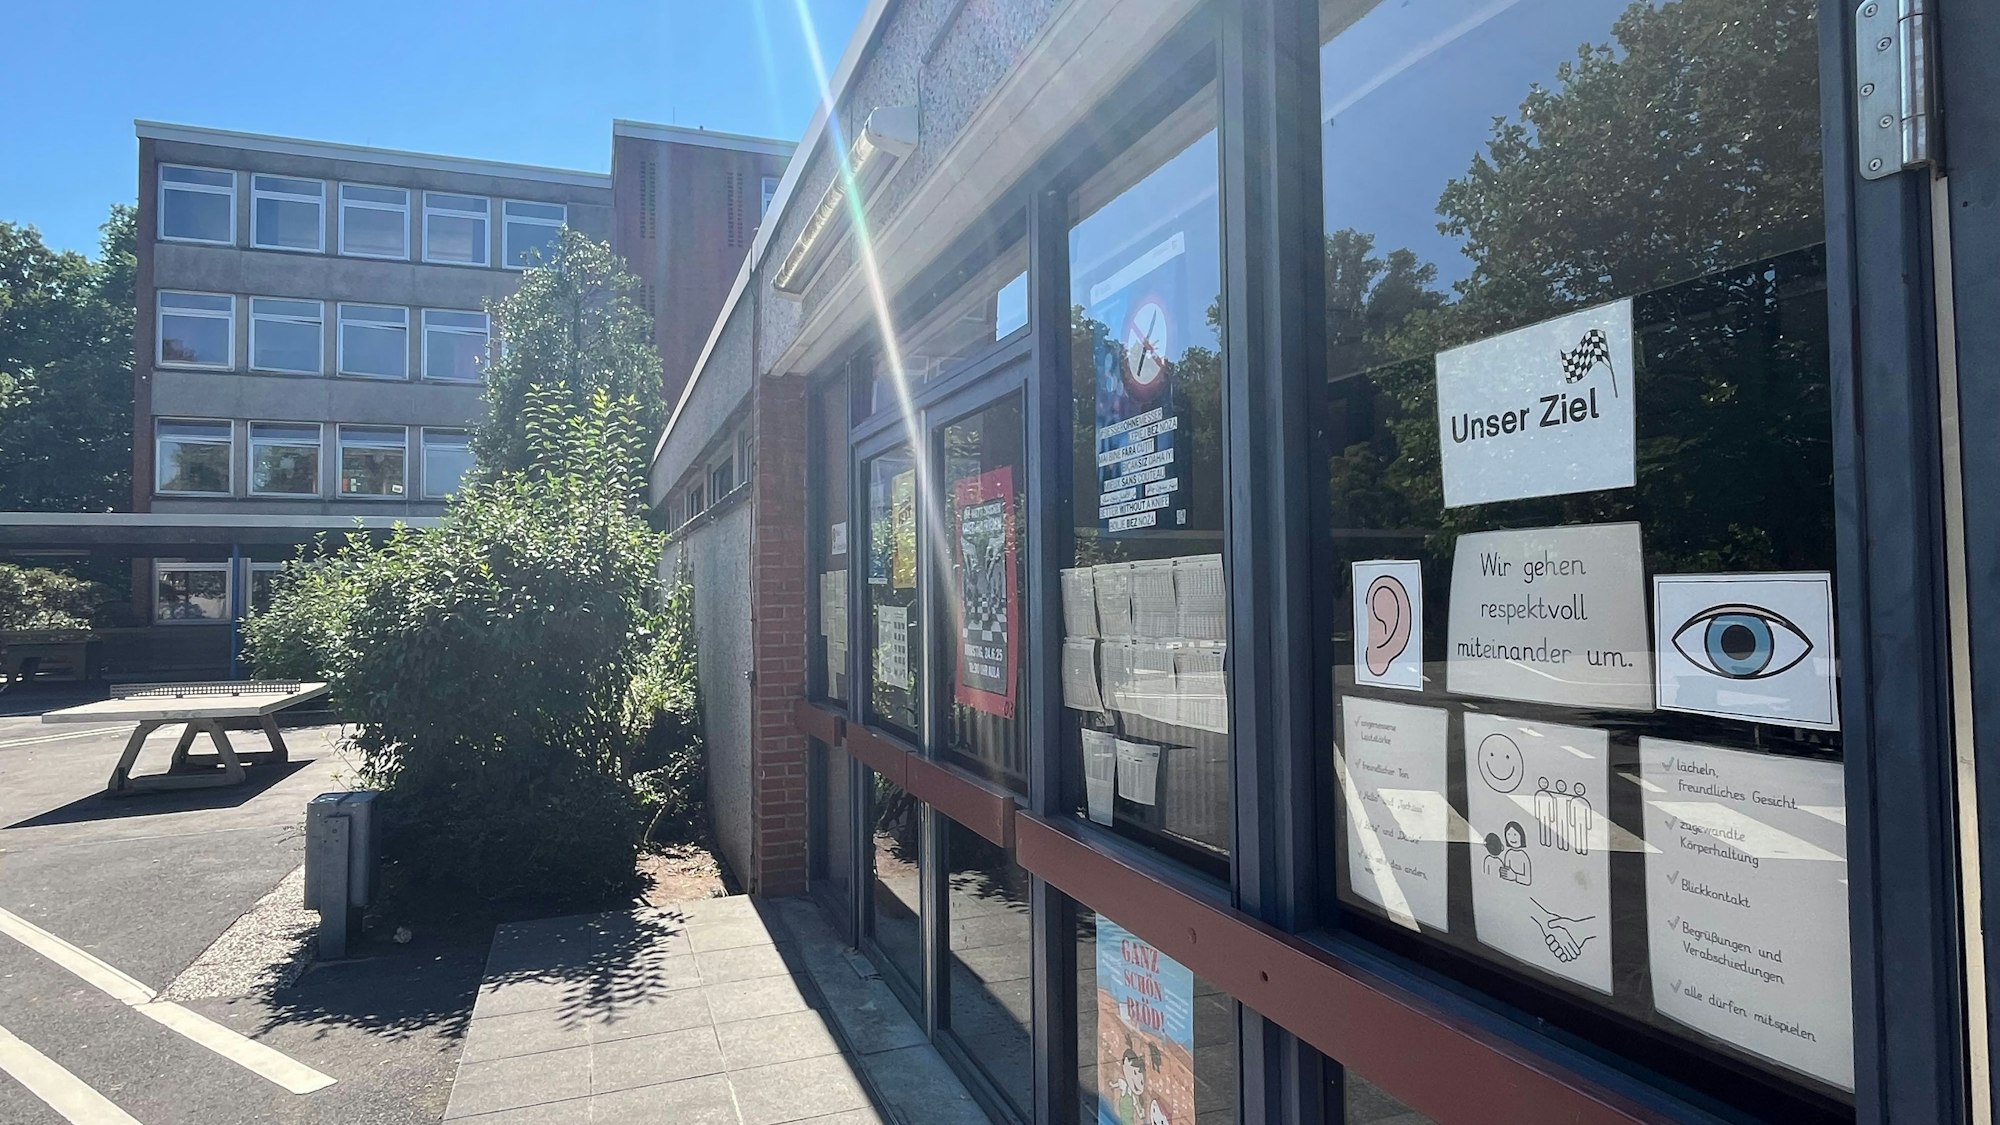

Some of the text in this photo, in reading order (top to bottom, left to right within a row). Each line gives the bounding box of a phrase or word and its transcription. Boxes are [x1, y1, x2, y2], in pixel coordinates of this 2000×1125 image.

[1147, 424, 1159, 436] BEZ
[1451, 387, 1600, 443] Unser Ziel
[1121, 475, 1137, 486] SANS
[1119, 500, 1146, 513] WITHOUT
[1126, 517, 1137, 527] BEZ
[1480, 549, 1587, 584] Wir gehen
[1481, 593, 1588, 625] respektvoll
[1457, 637, 1633, 668] miteinander um.
[1676, 758, 1719, 779] lächeln,
[1678, 779, 1799, 810] freundliches Gesicht
[1679, 820, 1746, 842] zugewandte
[1680, 836, 1760, 869] Körperhaltung
[1681, 878, 1751, 908] Blickkontakt
[1121, 939, 1160, 974] GANZ
[1682, 920, 1783, 964] Begrüßungen und
[1682, 940, 1785, 985] Verabschiedungen
[1123, 969, 1163, 1002] SCHÖN
[1126, 995, 1166, 1034] BLÖD!
[1684, 985, 1817, 1043] alle dürfen mitspielen
